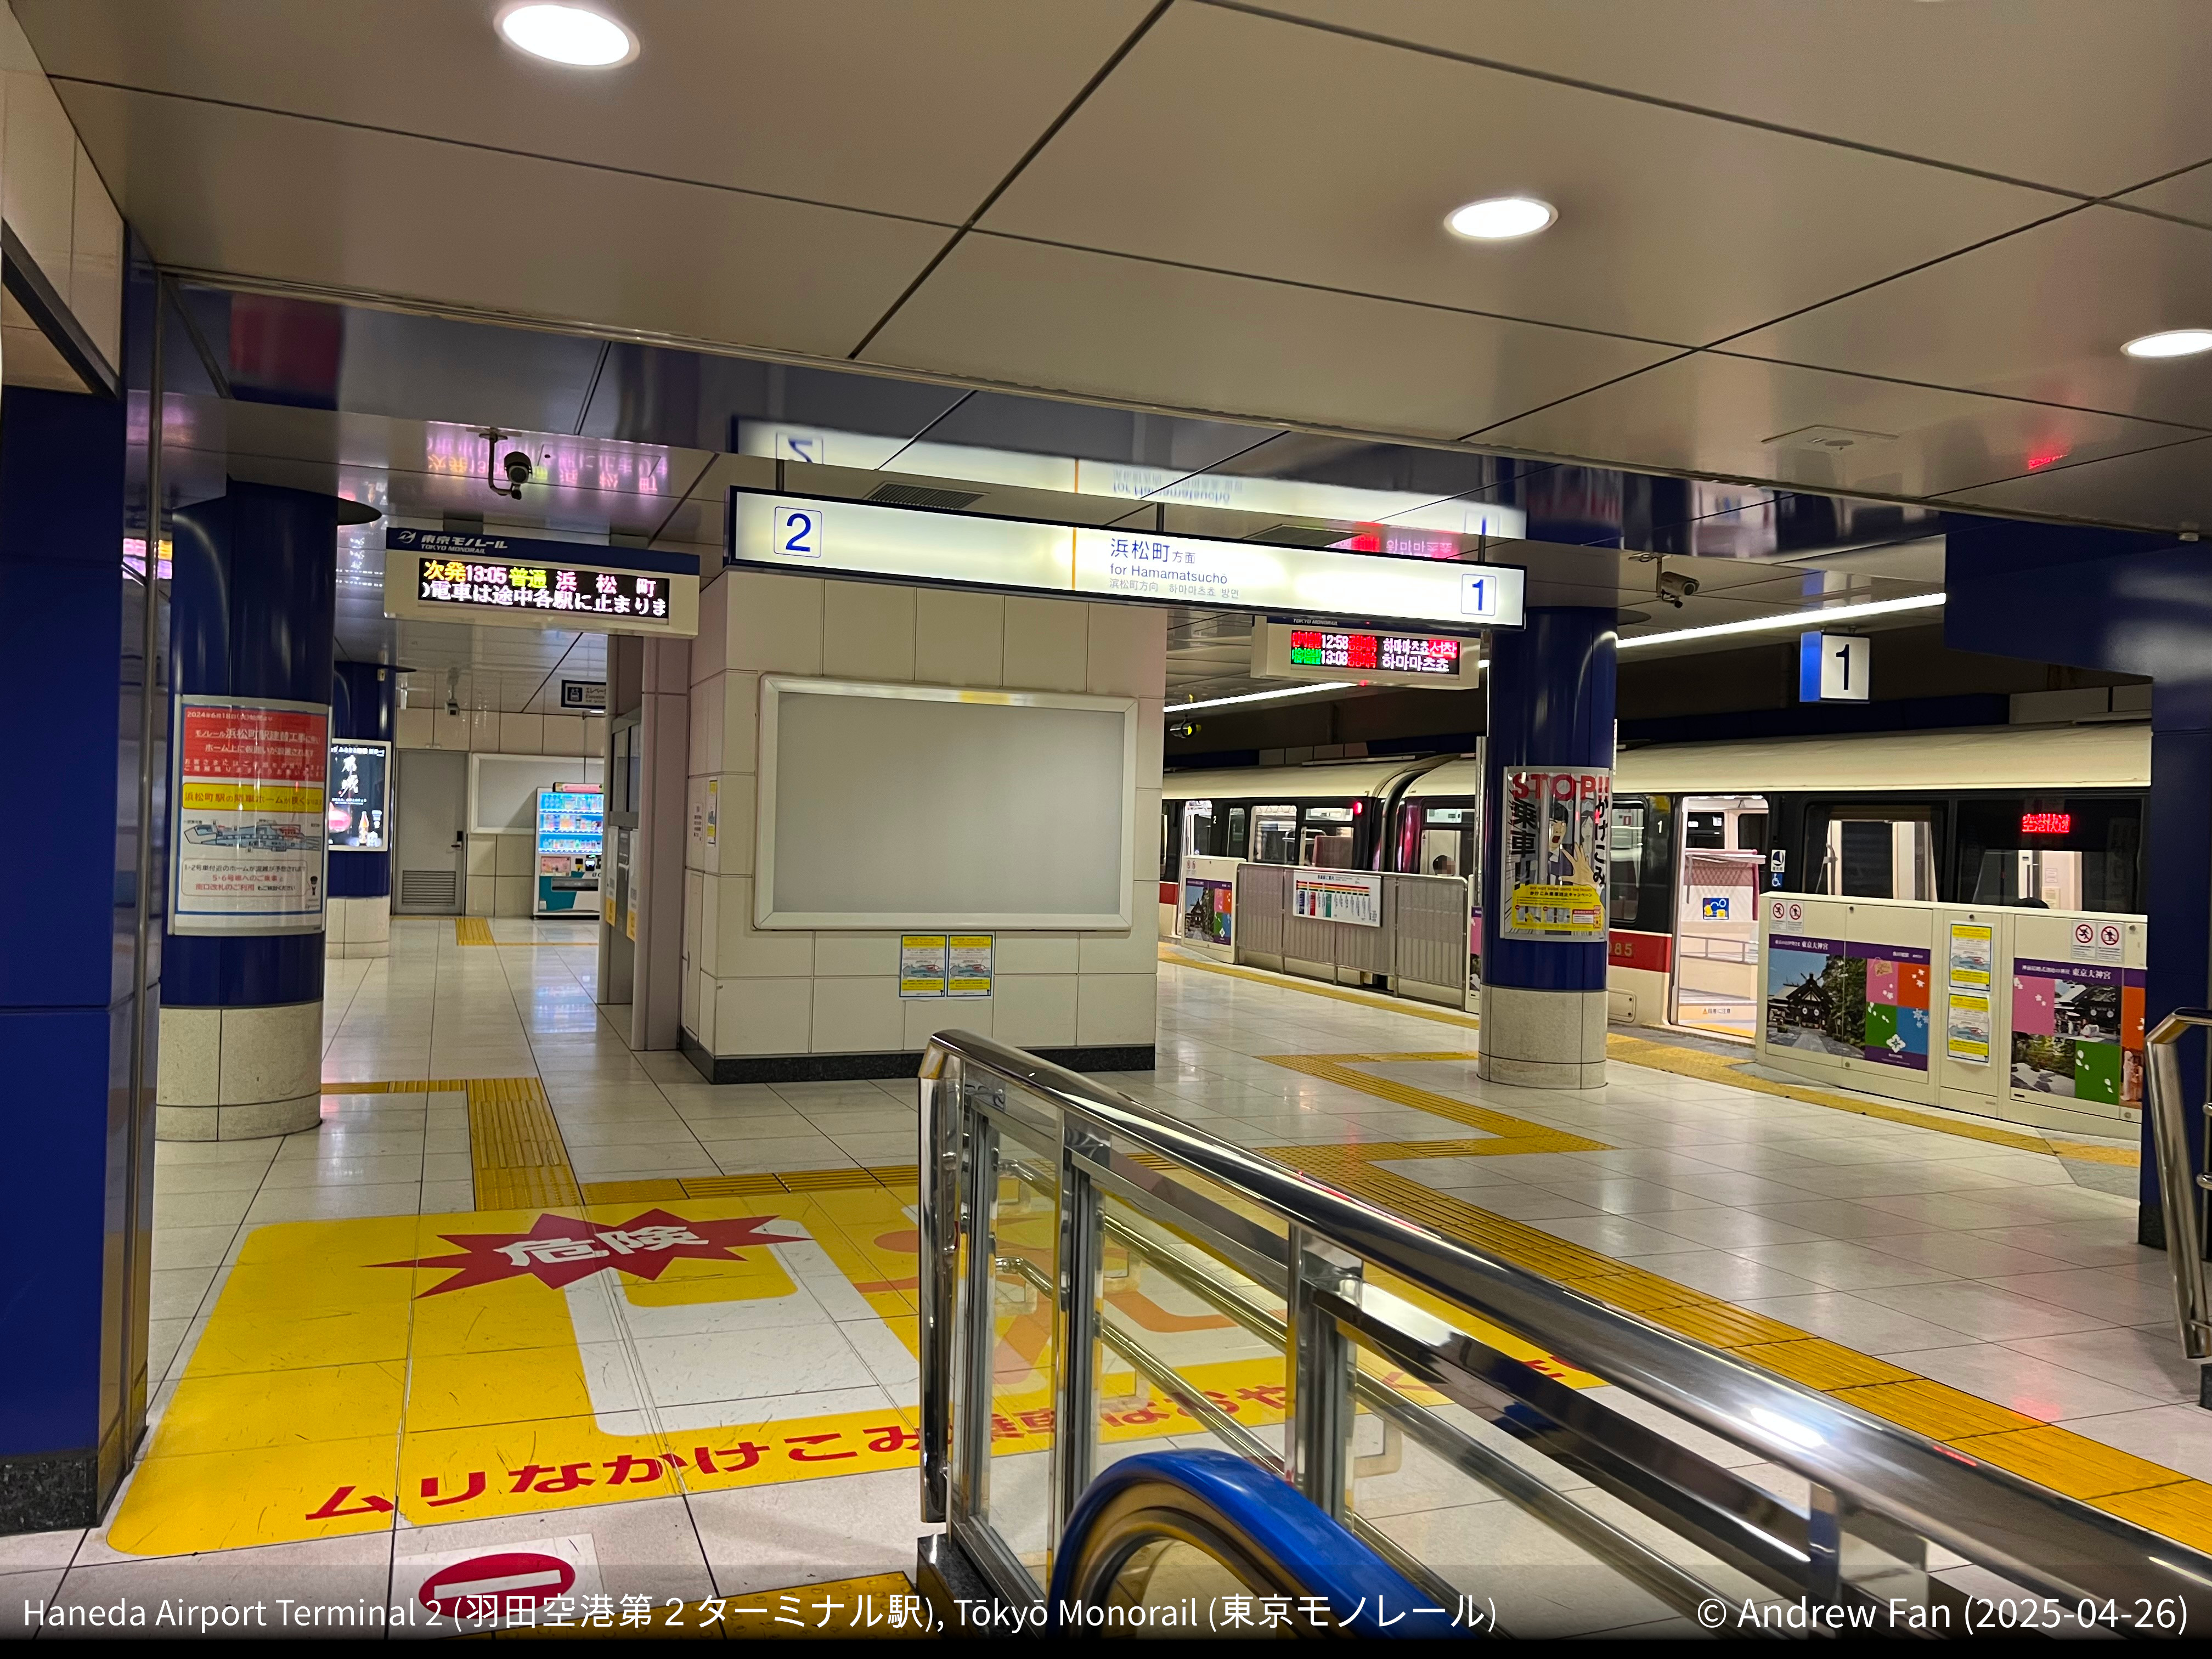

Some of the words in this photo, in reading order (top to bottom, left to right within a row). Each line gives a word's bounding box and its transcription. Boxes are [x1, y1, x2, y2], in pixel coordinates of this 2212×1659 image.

[785, 513, 811, 552] 2
[421, 535, 507, 549] 東京モノレール
[448, 546, 486, 554] MONORAIL
[466, 565, 507, 583] 13:05
[509, 567, 547, 589] 普通
[1110, 563, 1127, 575] for
[1221, 588, 1239, 599] 방면
[1471, 579, 1485, 611] 1
[1322, 634, 1348, 650] 12:58
[1321, 650, 1348, 665] 13:08
[1836, 644, 1849, 690] 1
[1513, 772, 1609, 801] STOP!!
[1213, 815, 1217, 824] 2
[1657, 820, 1662, 833] 1
[2022, 814, 2070, 833] 空港快速
[493, 1226, 709, 1266] 危険
